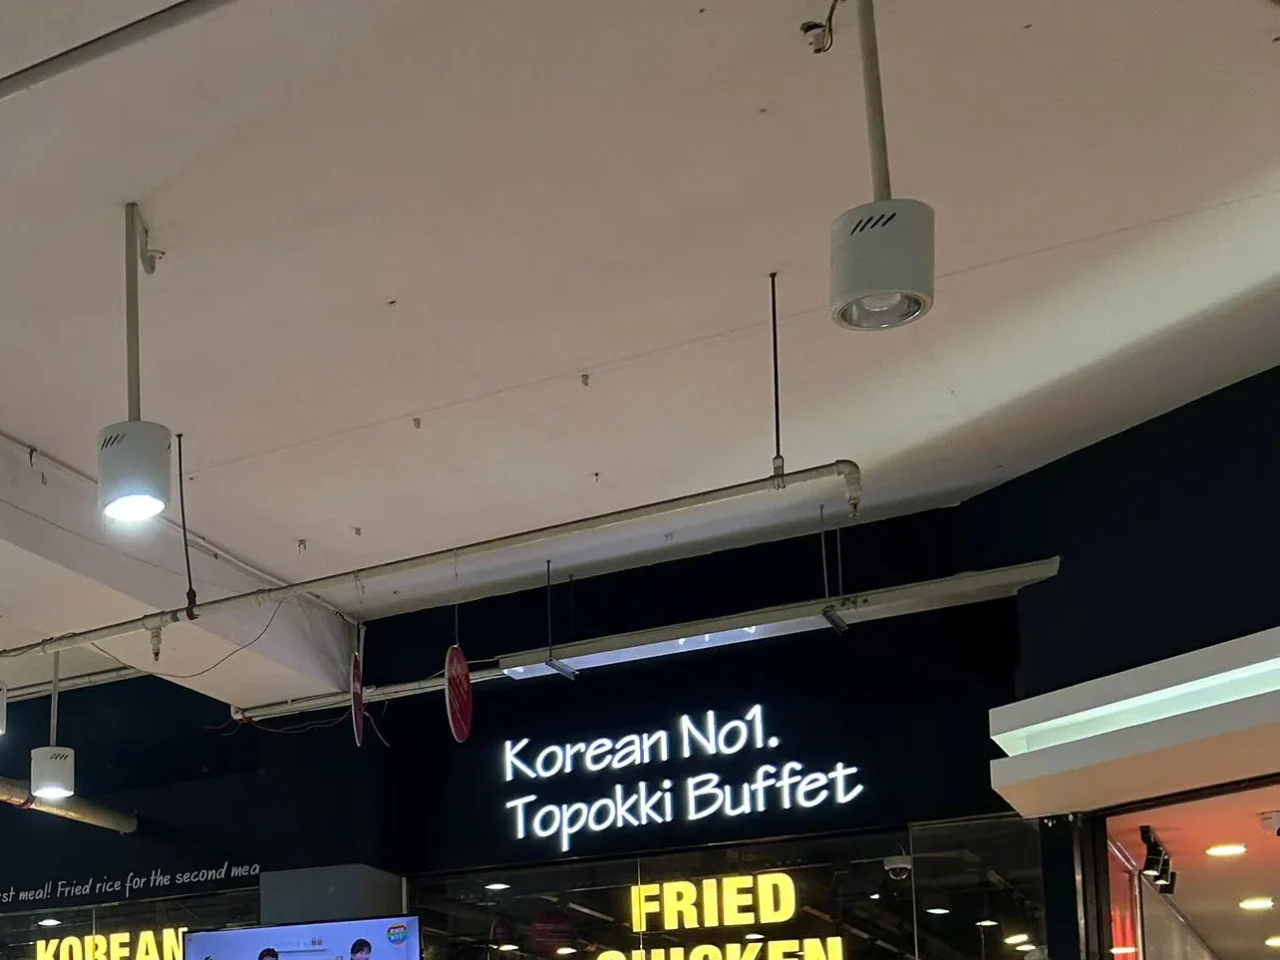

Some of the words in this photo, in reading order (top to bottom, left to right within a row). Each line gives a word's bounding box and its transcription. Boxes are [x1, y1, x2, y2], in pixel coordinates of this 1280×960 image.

[504, 729, 669, 782] Korean
[505, 780, 672, 852] Topokki
[687, 762, 864, 820] Buffet
[19, 881, 52, 900] meal!
[57, 878, 93, 897] Fried
[96, 876, 121, 893] rice
[125, 872, 147, 898] for
[150, 868, 170, 888] the
[175, 861, 228, 884] second
[631, 872, 796, 933] FRIED
